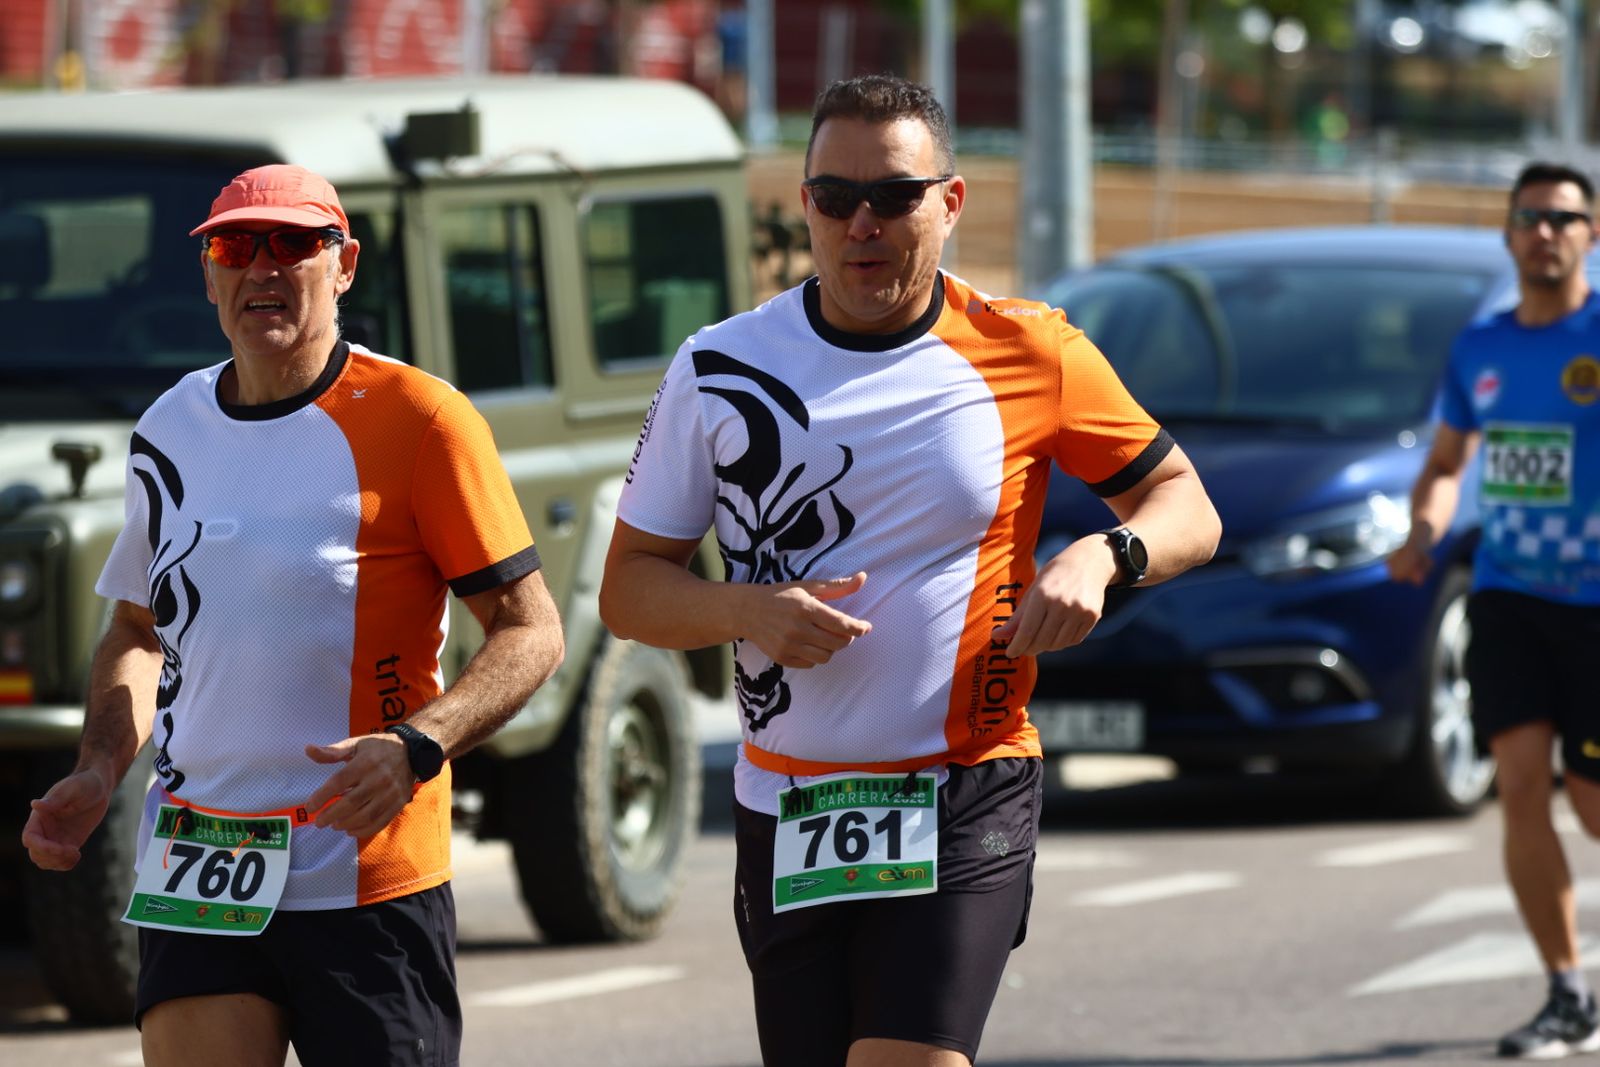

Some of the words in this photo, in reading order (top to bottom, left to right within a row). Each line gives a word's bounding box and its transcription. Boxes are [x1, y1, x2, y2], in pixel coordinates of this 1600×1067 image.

[1492, 446, 1564, 484] 1002
[818, 791, 890, 810] CARRERA
[855, 780, 930, 793] FERNADO
[196, 827, 254, 844] CARRERA
[799, 810, 901, 869] 761
[164, 843, 266, 902] 760
